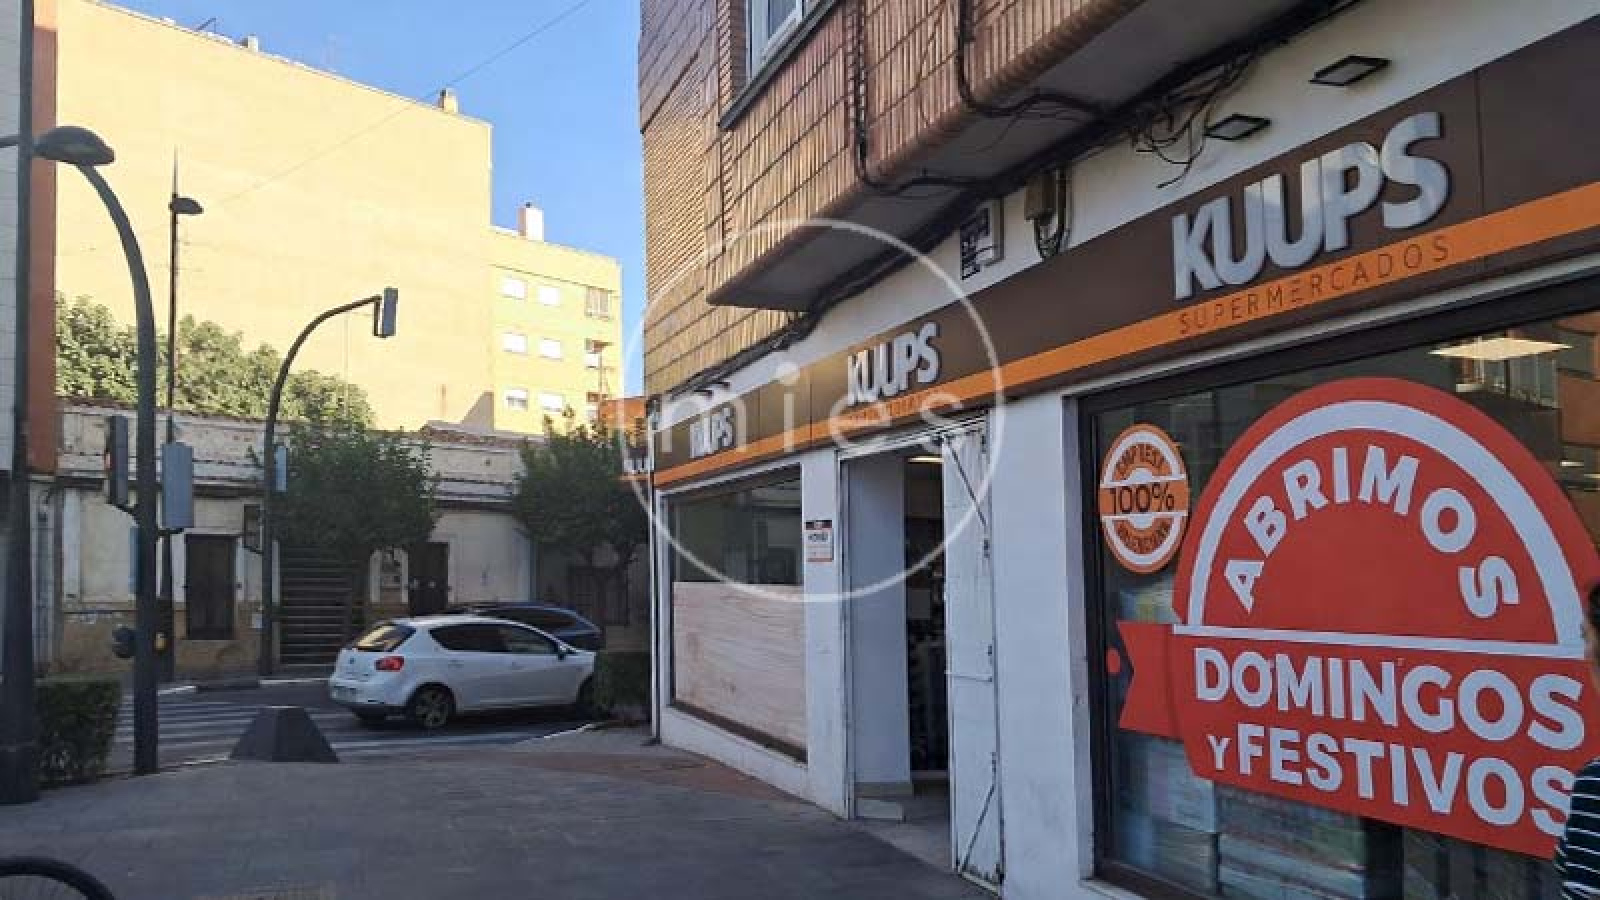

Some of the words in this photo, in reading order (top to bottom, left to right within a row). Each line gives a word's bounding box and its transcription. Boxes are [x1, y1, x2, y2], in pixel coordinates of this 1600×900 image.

[1171, 111, 1449, 300] KUUPS
[1178, 234, 1450, 336] SUPERMERCADOS
[847, 322, 939, 406] KUUPS
[1110, 482, 1175, 514] 100%
[1224, 445, 1520, 619] ABRIMOS
[1193, 647, 1586, 751] DOMINGOS
[1207, 735, 1231, 771] Y
[1236, 722, 1576, 838] FESTIVOS
